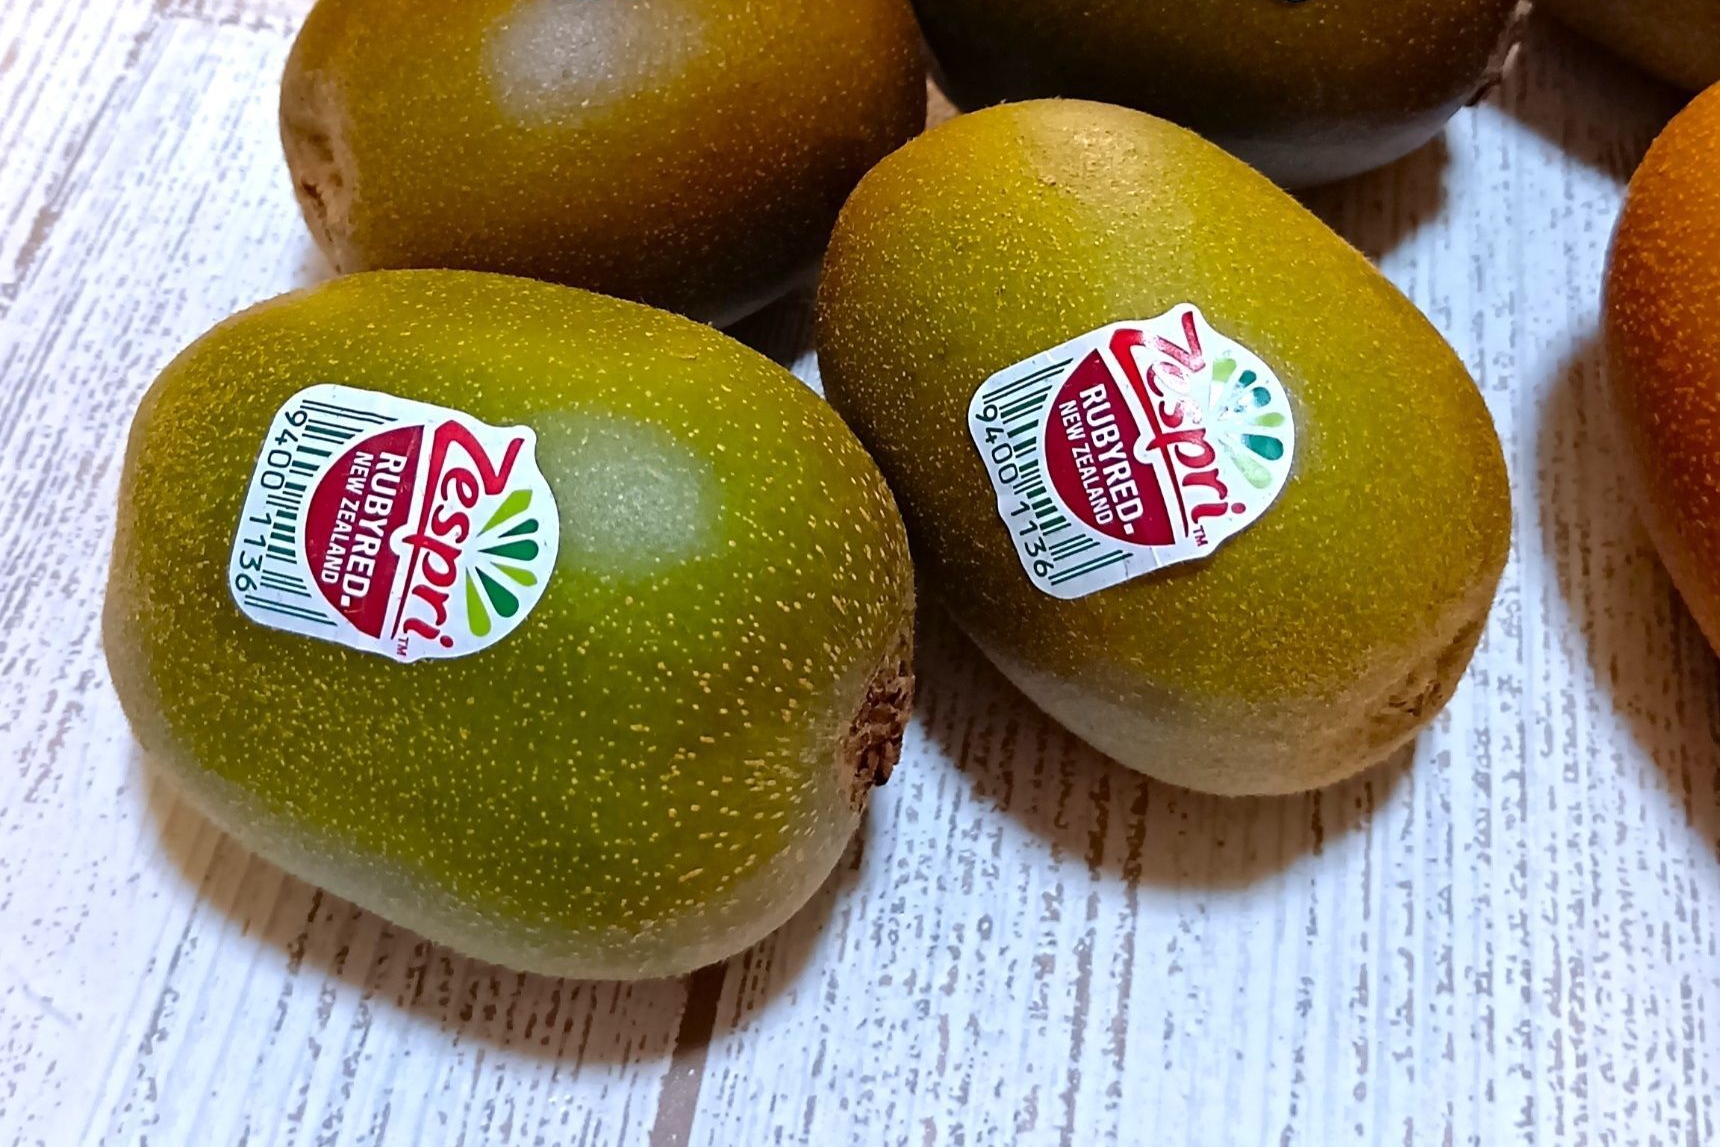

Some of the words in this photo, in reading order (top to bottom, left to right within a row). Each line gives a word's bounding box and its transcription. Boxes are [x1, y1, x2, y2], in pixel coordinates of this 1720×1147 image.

[261, 410, 308, 491] 9400
[1059, 400, 1086, 442] NEW
[345, 451, 374, 493] NEW
[975, 404, 1020, 485] 9400
[1010, 500, 1055, 579] 1136
[1071, 444, 1113, 525] ZEALAND
[235, 513, 274, 592] 1136
[321, 500, 361, 585] ZEALAND
[391, 419, 525, 648] Zespri
